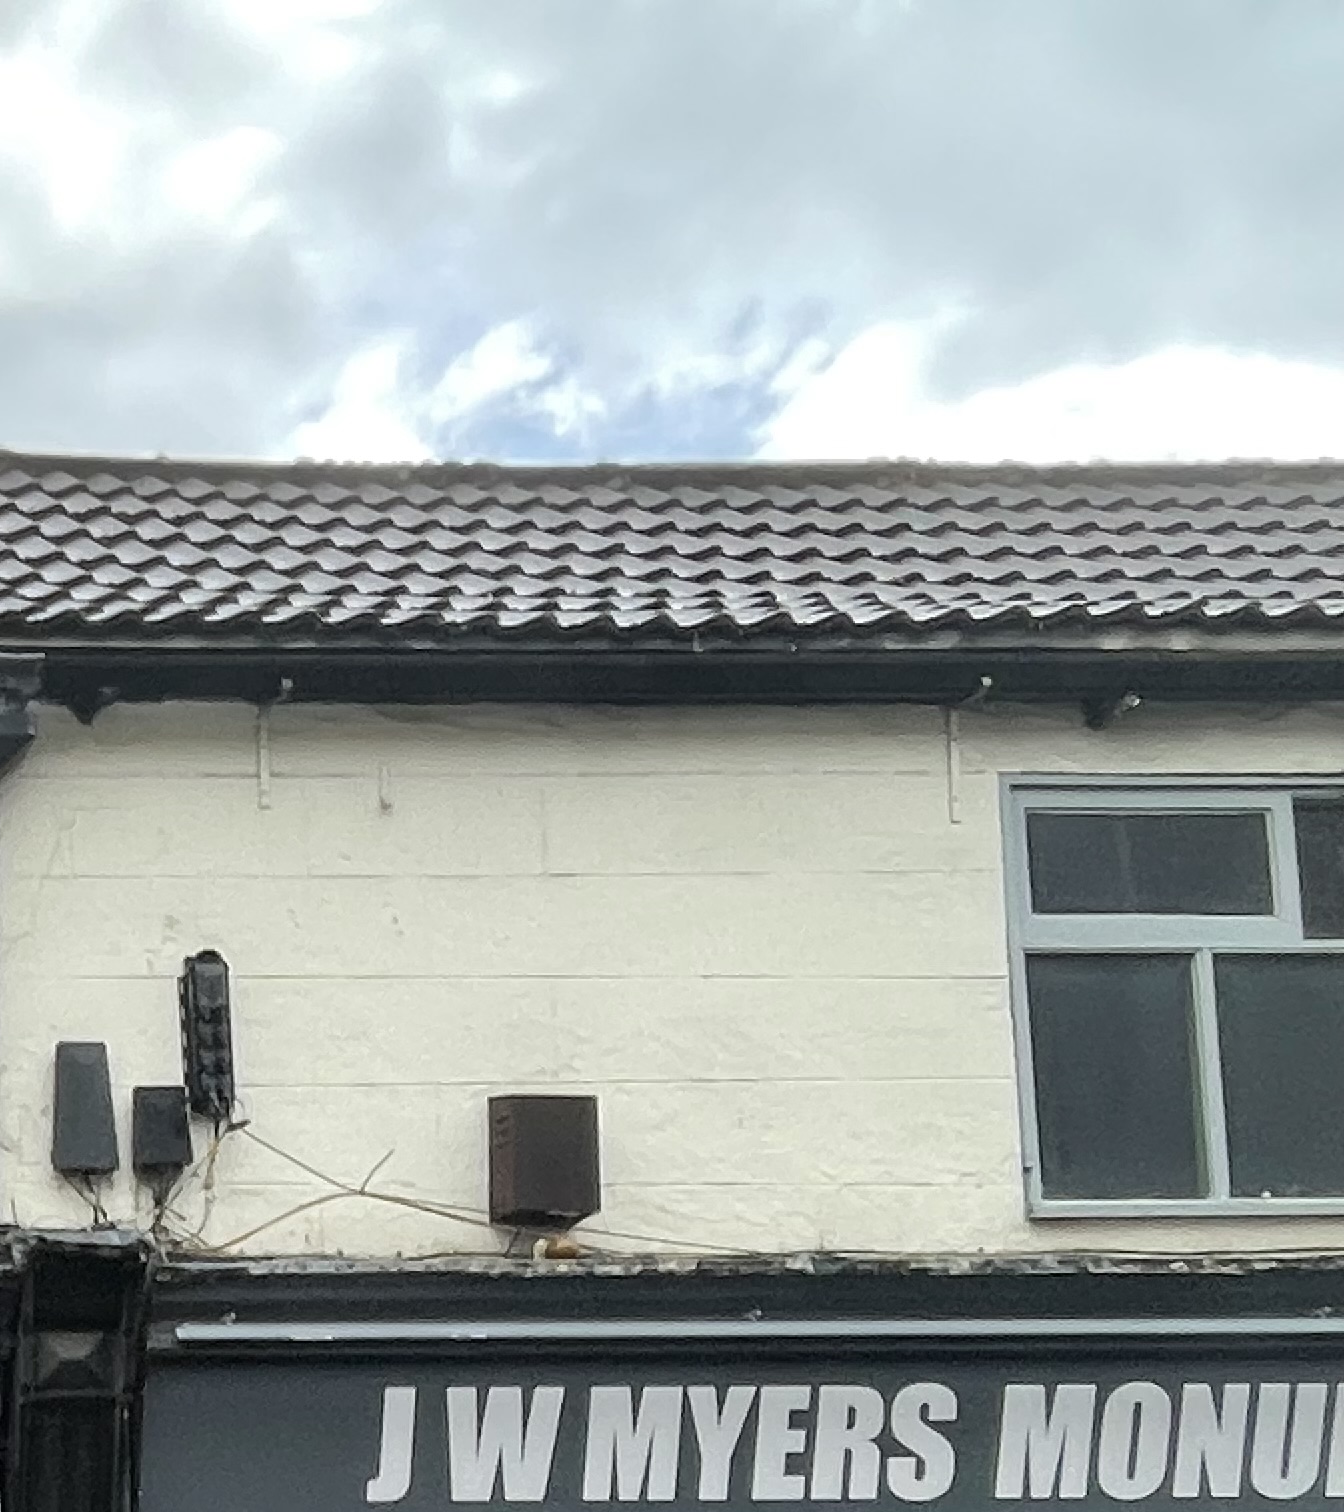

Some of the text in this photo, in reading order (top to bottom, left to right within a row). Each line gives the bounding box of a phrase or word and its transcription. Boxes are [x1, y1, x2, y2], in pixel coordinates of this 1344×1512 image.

[365, 1385, 417, 1503] J
[446, 1385, 565, 1503] W
[582, 1382, 958, 1503] MYERS
